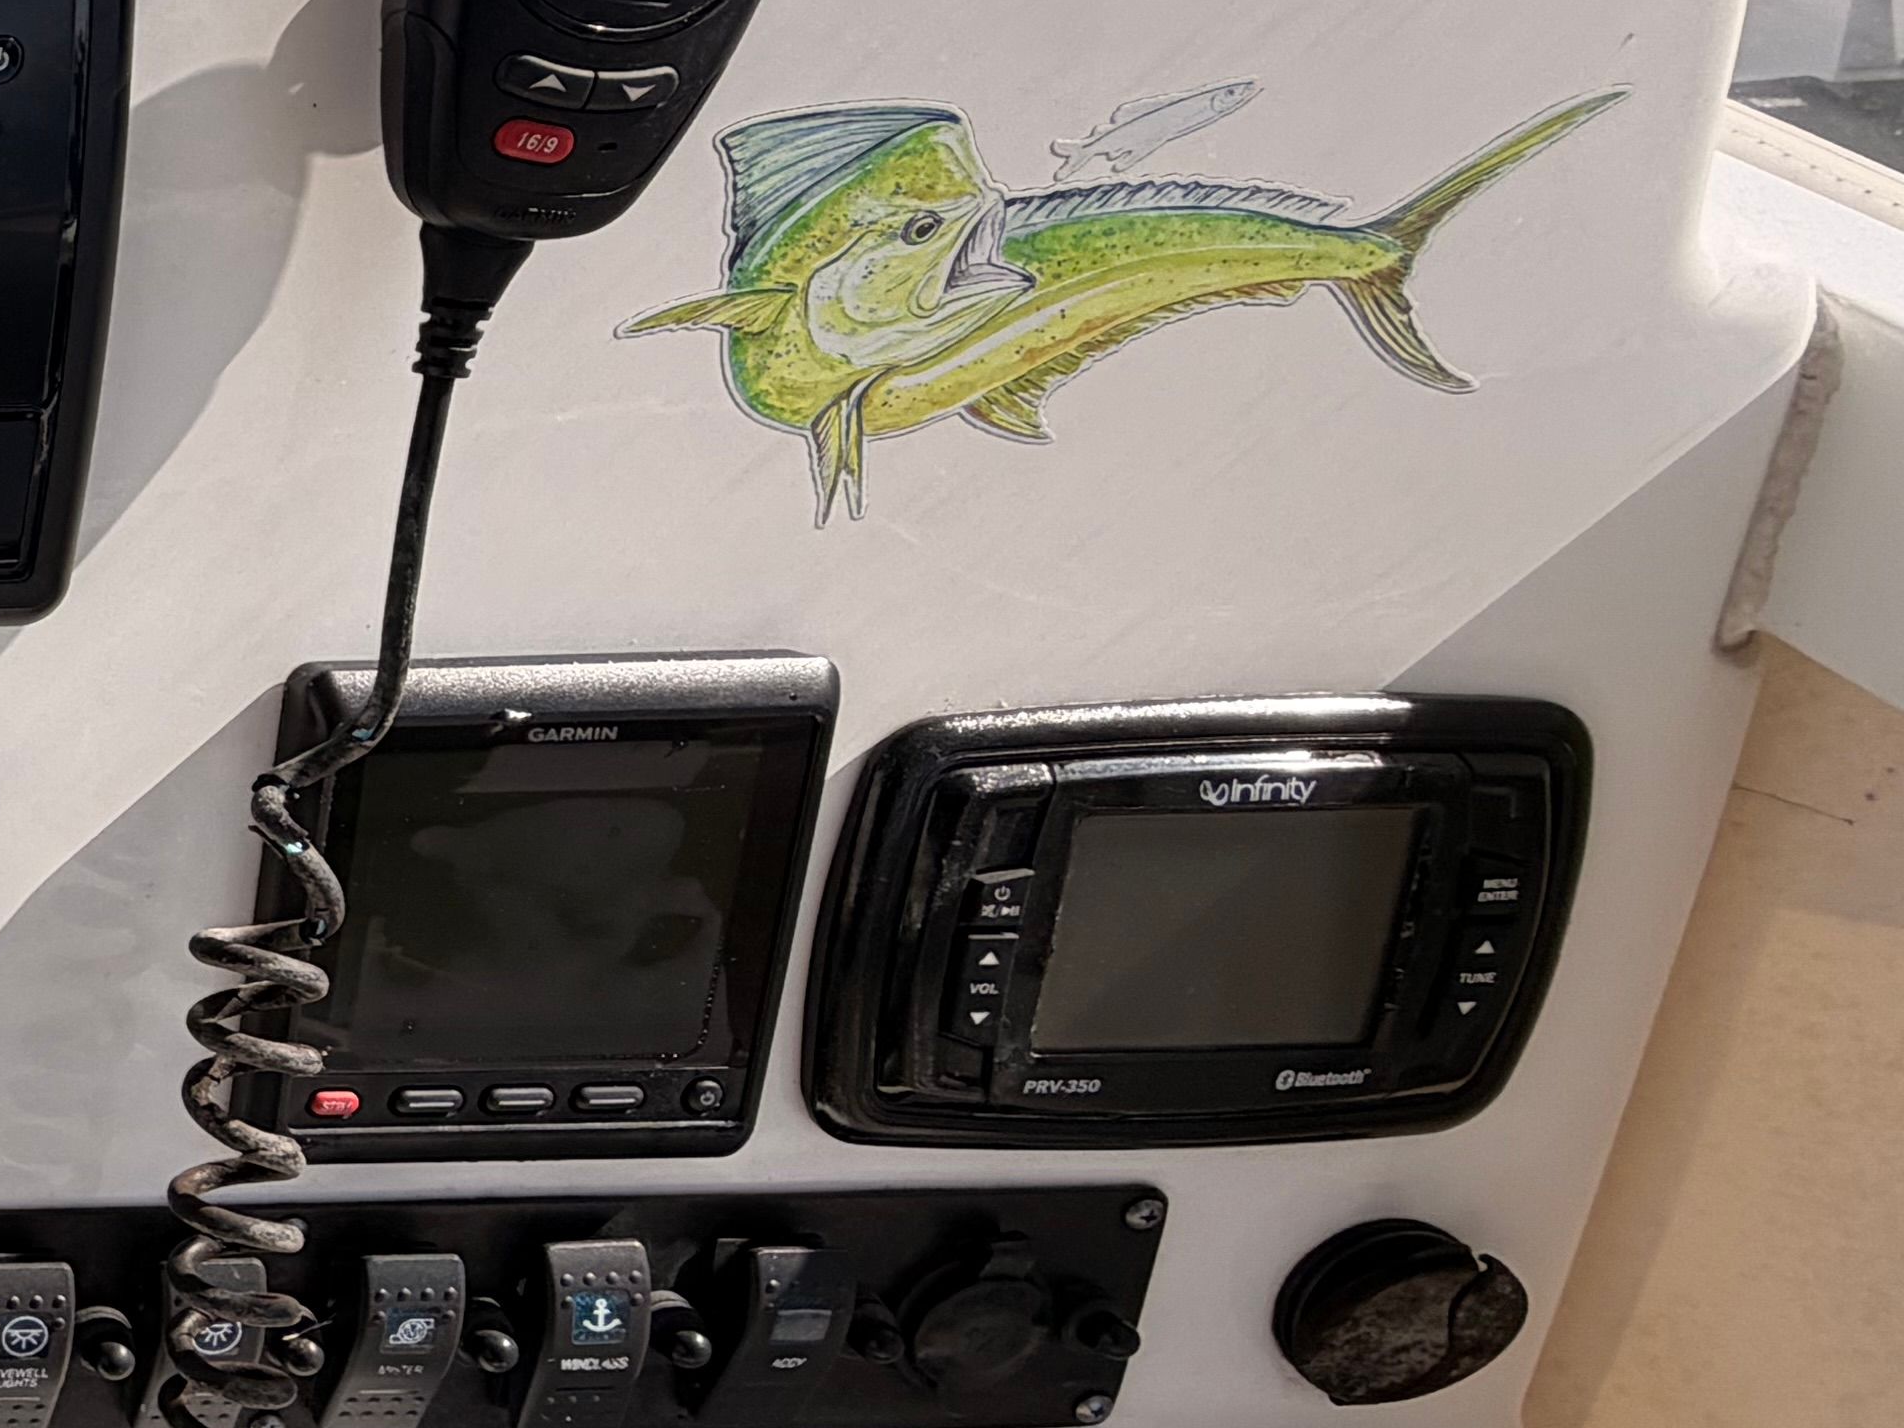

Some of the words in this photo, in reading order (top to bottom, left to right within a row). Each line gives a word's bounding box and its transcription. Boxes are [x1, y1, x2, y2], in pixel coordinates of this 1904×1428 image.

[516, 131, 559, 154] 16/9
[527, 726, 618, 742] GARMIN
[1231, 774, 1317, 805] Infinity
[1459, 972, 1496, 984] TUNE
[970, 983, 999, 994] VOL
[1023, 1079, 1102, 1094] PRV-350
